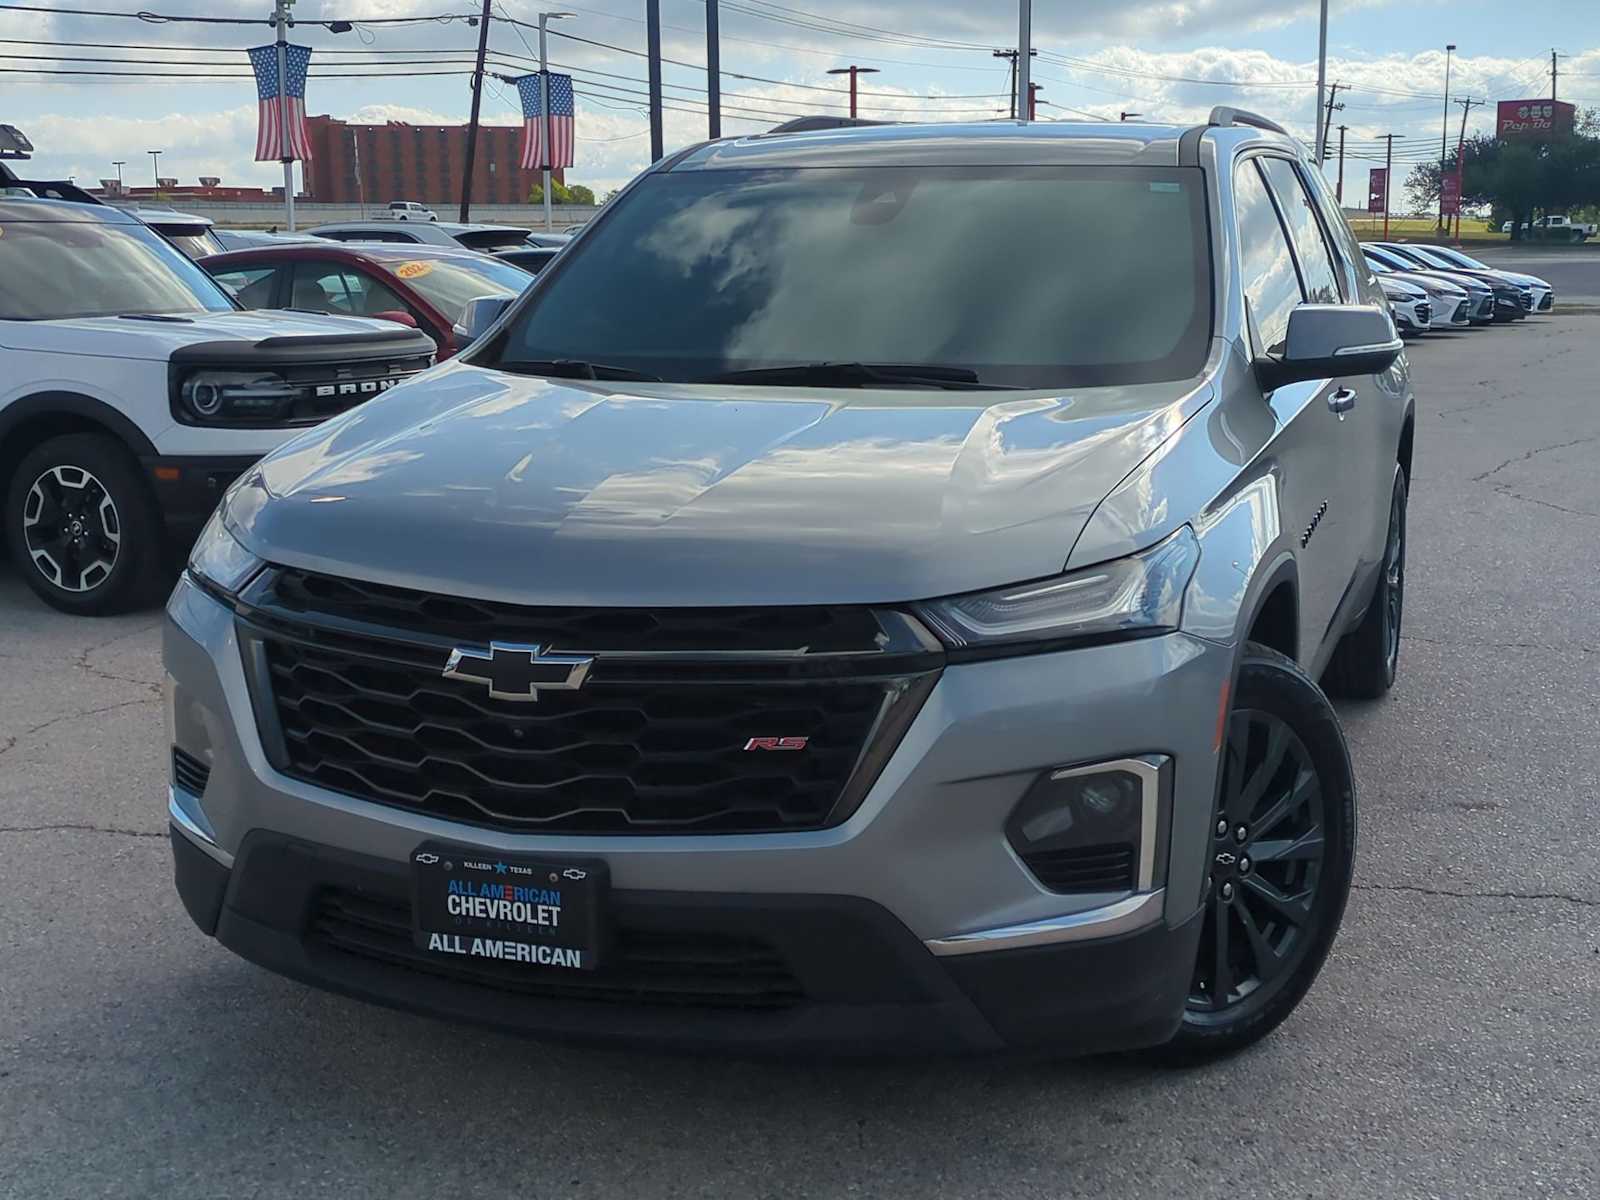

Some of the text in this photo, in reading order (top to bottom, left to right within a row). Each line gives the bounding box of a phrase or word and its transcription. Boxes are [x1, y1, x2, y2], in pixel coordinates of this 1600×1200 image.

[316, 380, 400, 396] BRON
[743, 736, 808, 751] RS
[463, 861, 533, 875] KILLEEN TEXAS
[448, 879, 561, 906] ALL AMERICAN
[447, 894, 561, 927] CHEVROLET
[428, 932, 581, 969] ALL AMERICAN
